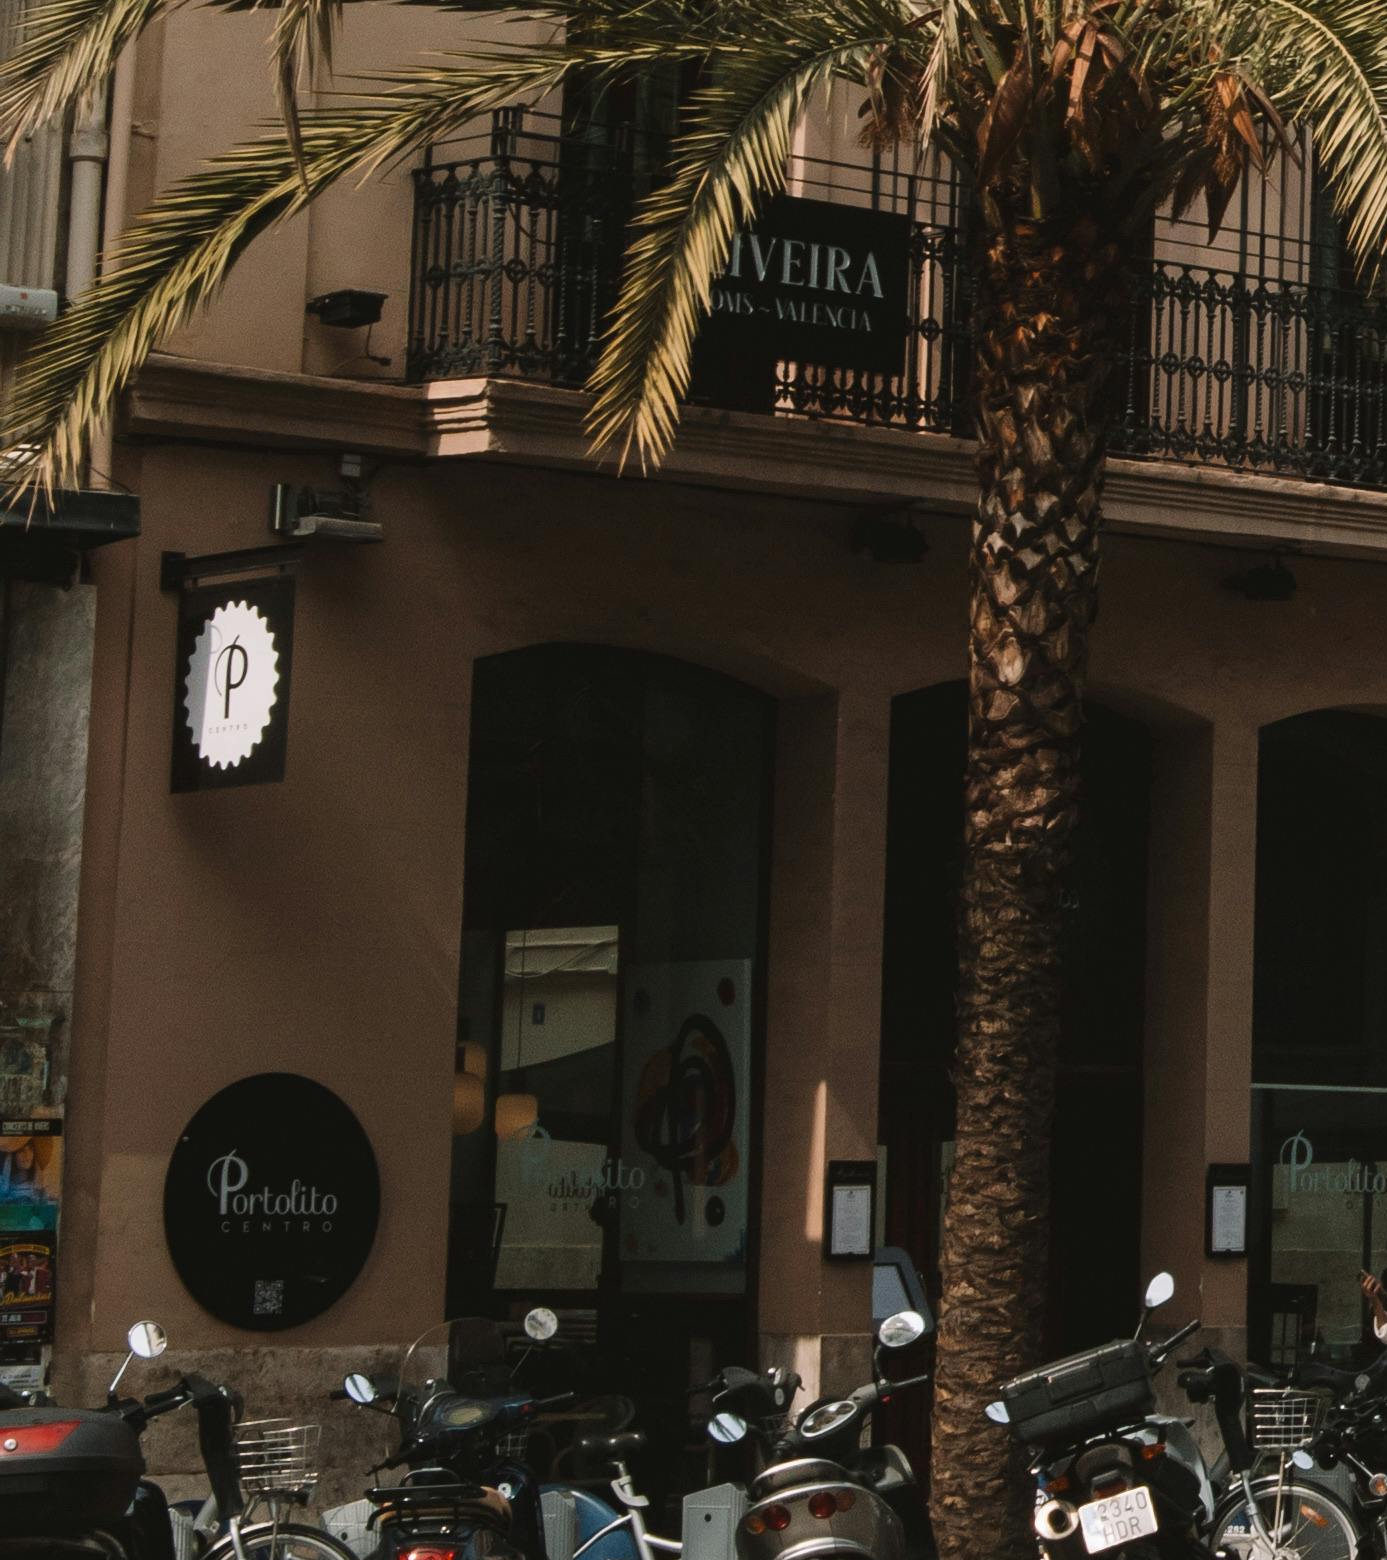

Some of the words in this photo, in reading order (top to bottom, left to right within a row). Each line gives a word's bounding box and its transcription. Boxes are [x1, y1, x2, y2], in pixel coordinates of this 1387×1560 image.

[712, 230, 884, 299] IVEIRA
[697, 288, 754, 314] OMS
[776, 297, 871, 331] VALENCIA
[207, 1148, 338, 1216] Portolito
[221, 1221, 333, 1233] CENTRO
[1096, 1491, 1147, 1522] 2340
[1102, 1516, 1142, 1544] HDR
